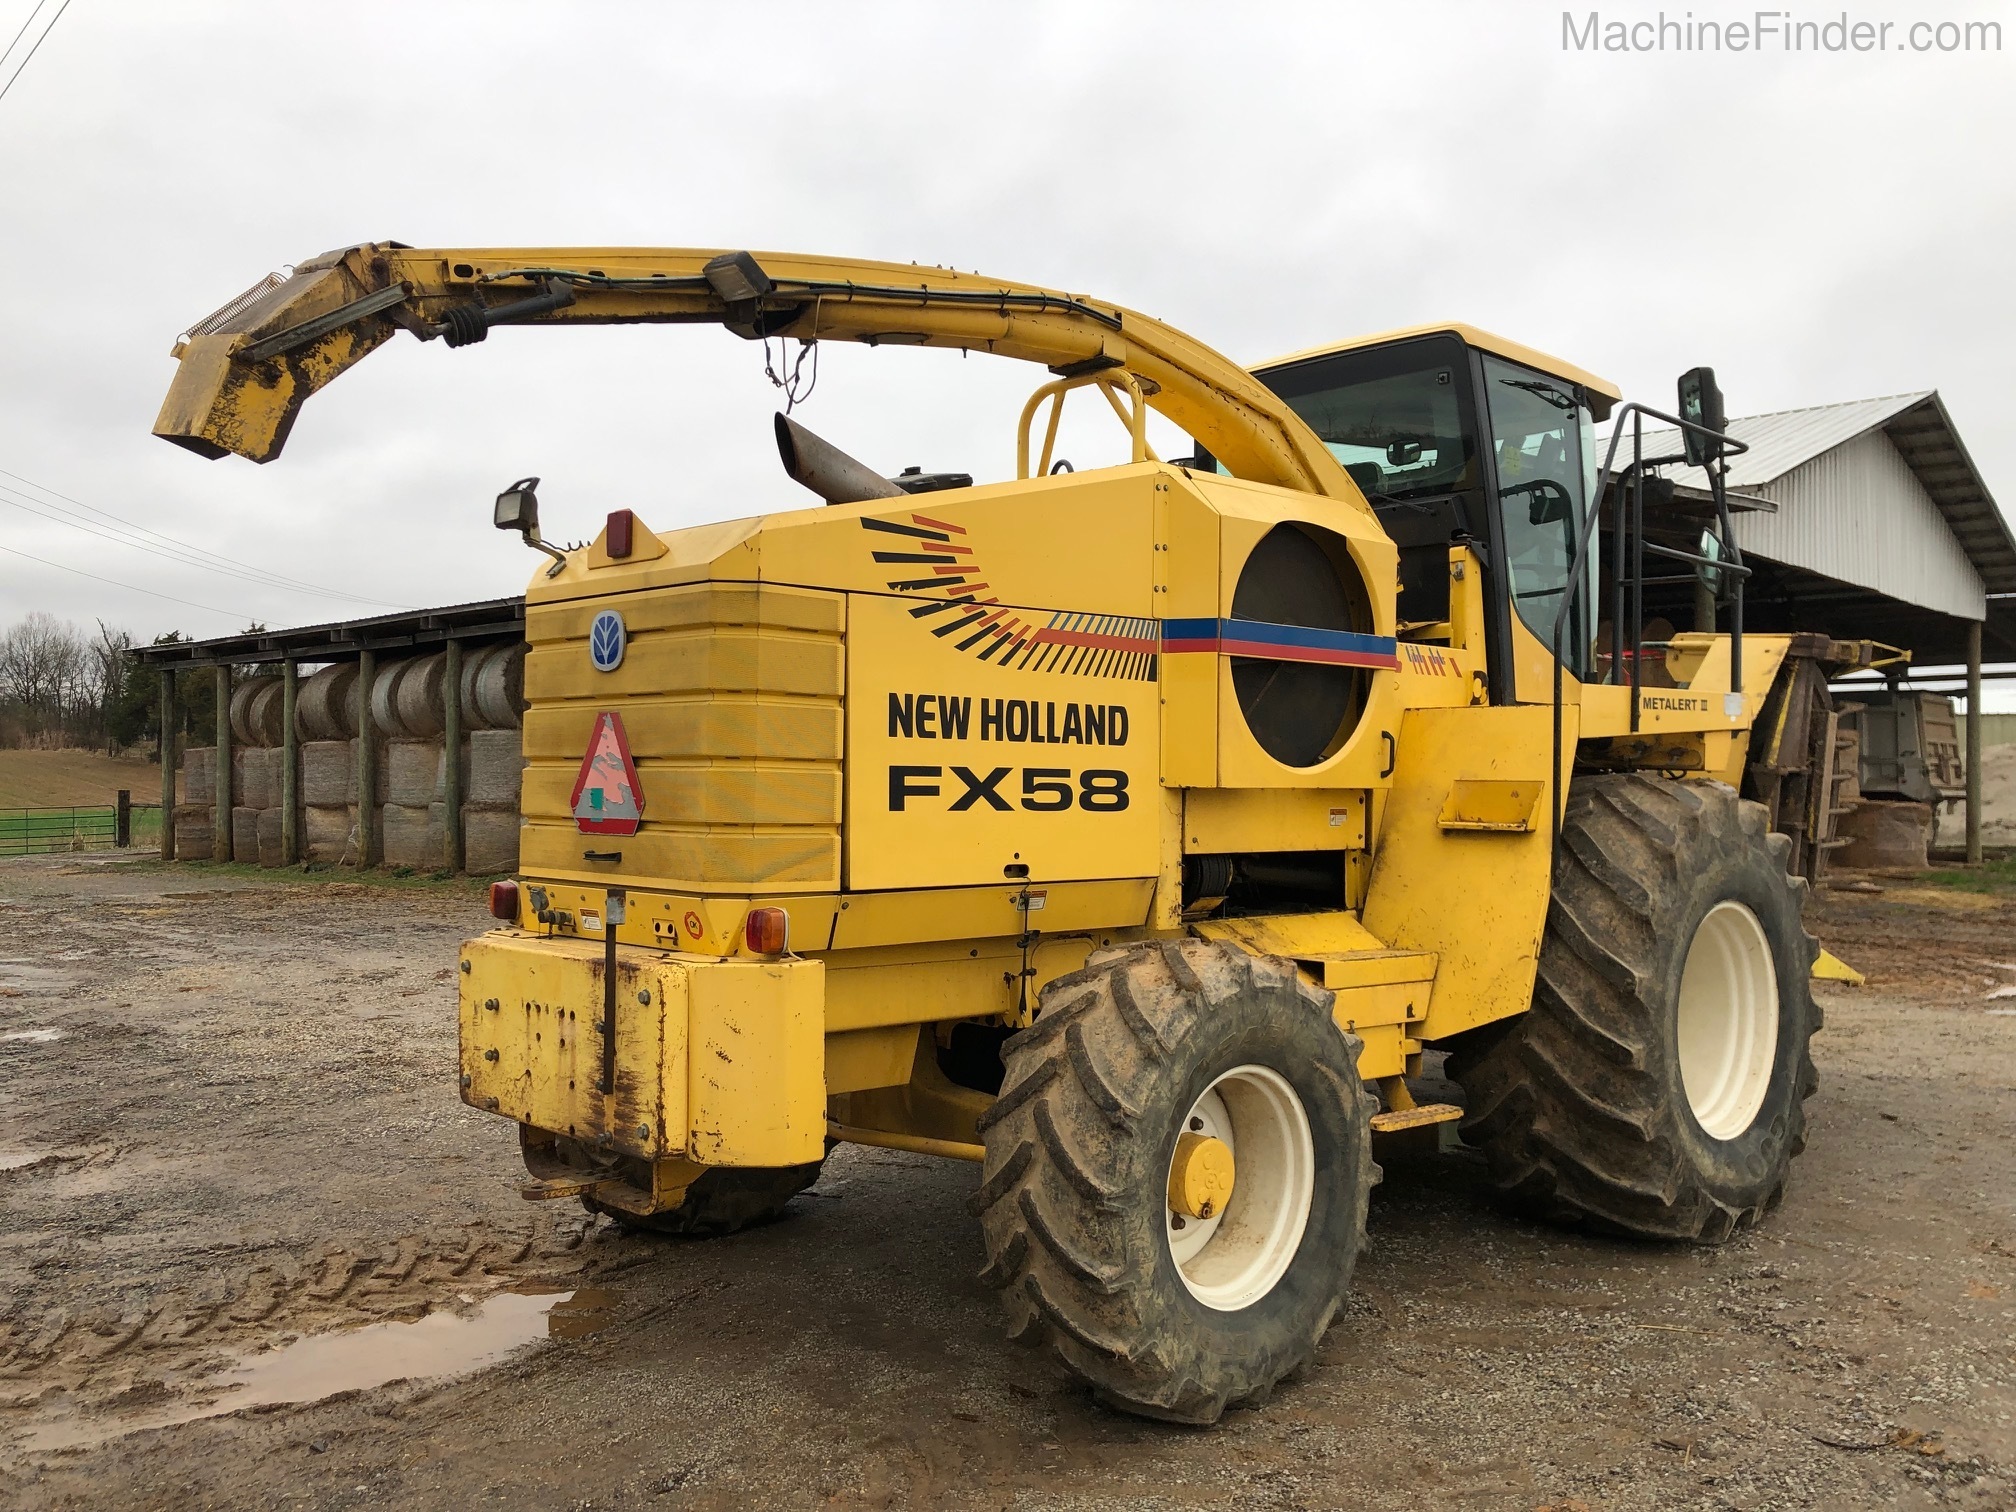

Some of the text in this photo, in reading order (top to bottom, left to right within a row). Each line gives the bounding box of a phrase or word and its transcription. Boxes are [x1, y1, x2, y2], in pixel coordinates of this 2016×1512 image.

[888, 692, 1129, 746] NEW HOLLAND
[1643, 697, 1697, 711] METALERT
[888, 765, 1130, 812] FX58
